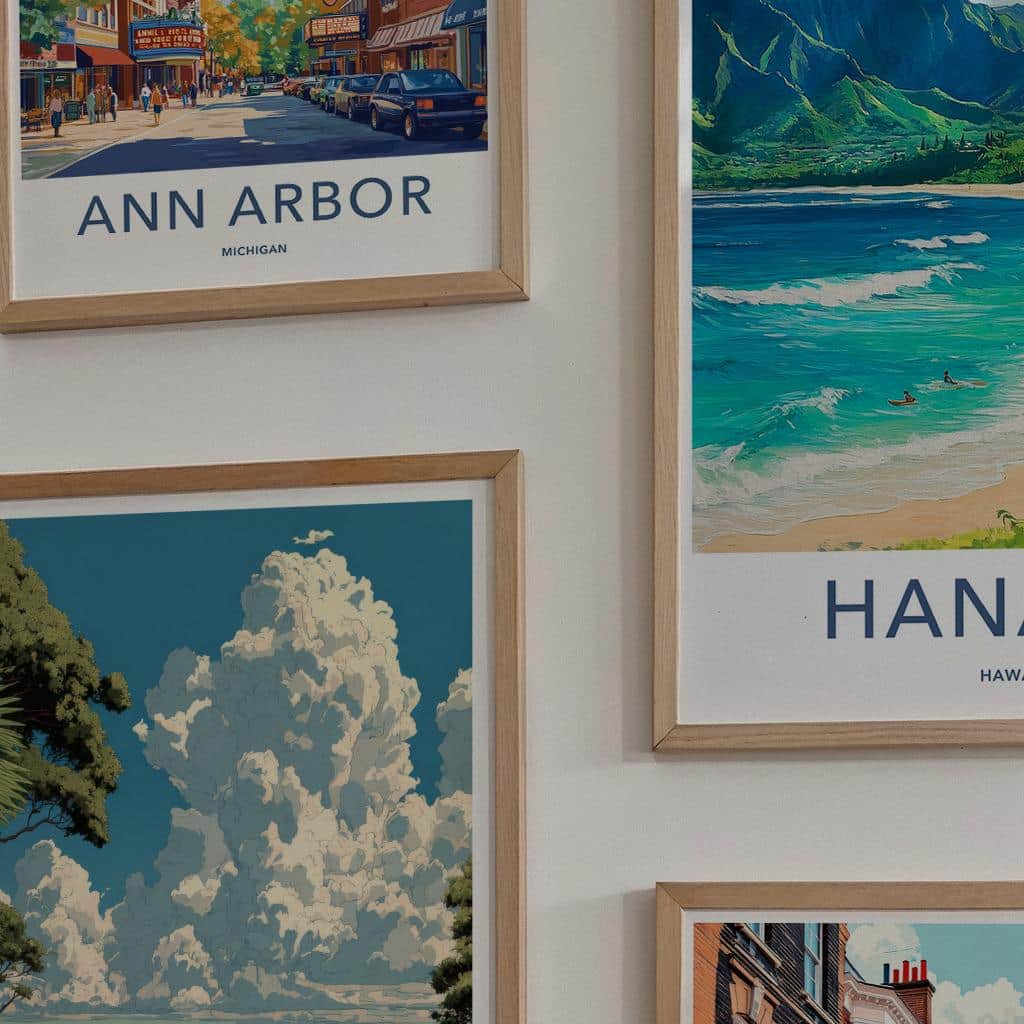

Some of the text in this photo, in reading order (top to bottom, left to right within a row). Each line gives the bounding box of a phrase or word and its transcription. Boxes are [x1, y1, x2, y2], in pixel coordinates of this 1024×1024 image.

[76, 175, 432, 236] ANN ARBOR
[222, 243, 288, 257] MICHIGAN
[826, 577, 1024, 640] HAN
[980, 668, 1024, 682] HAW
